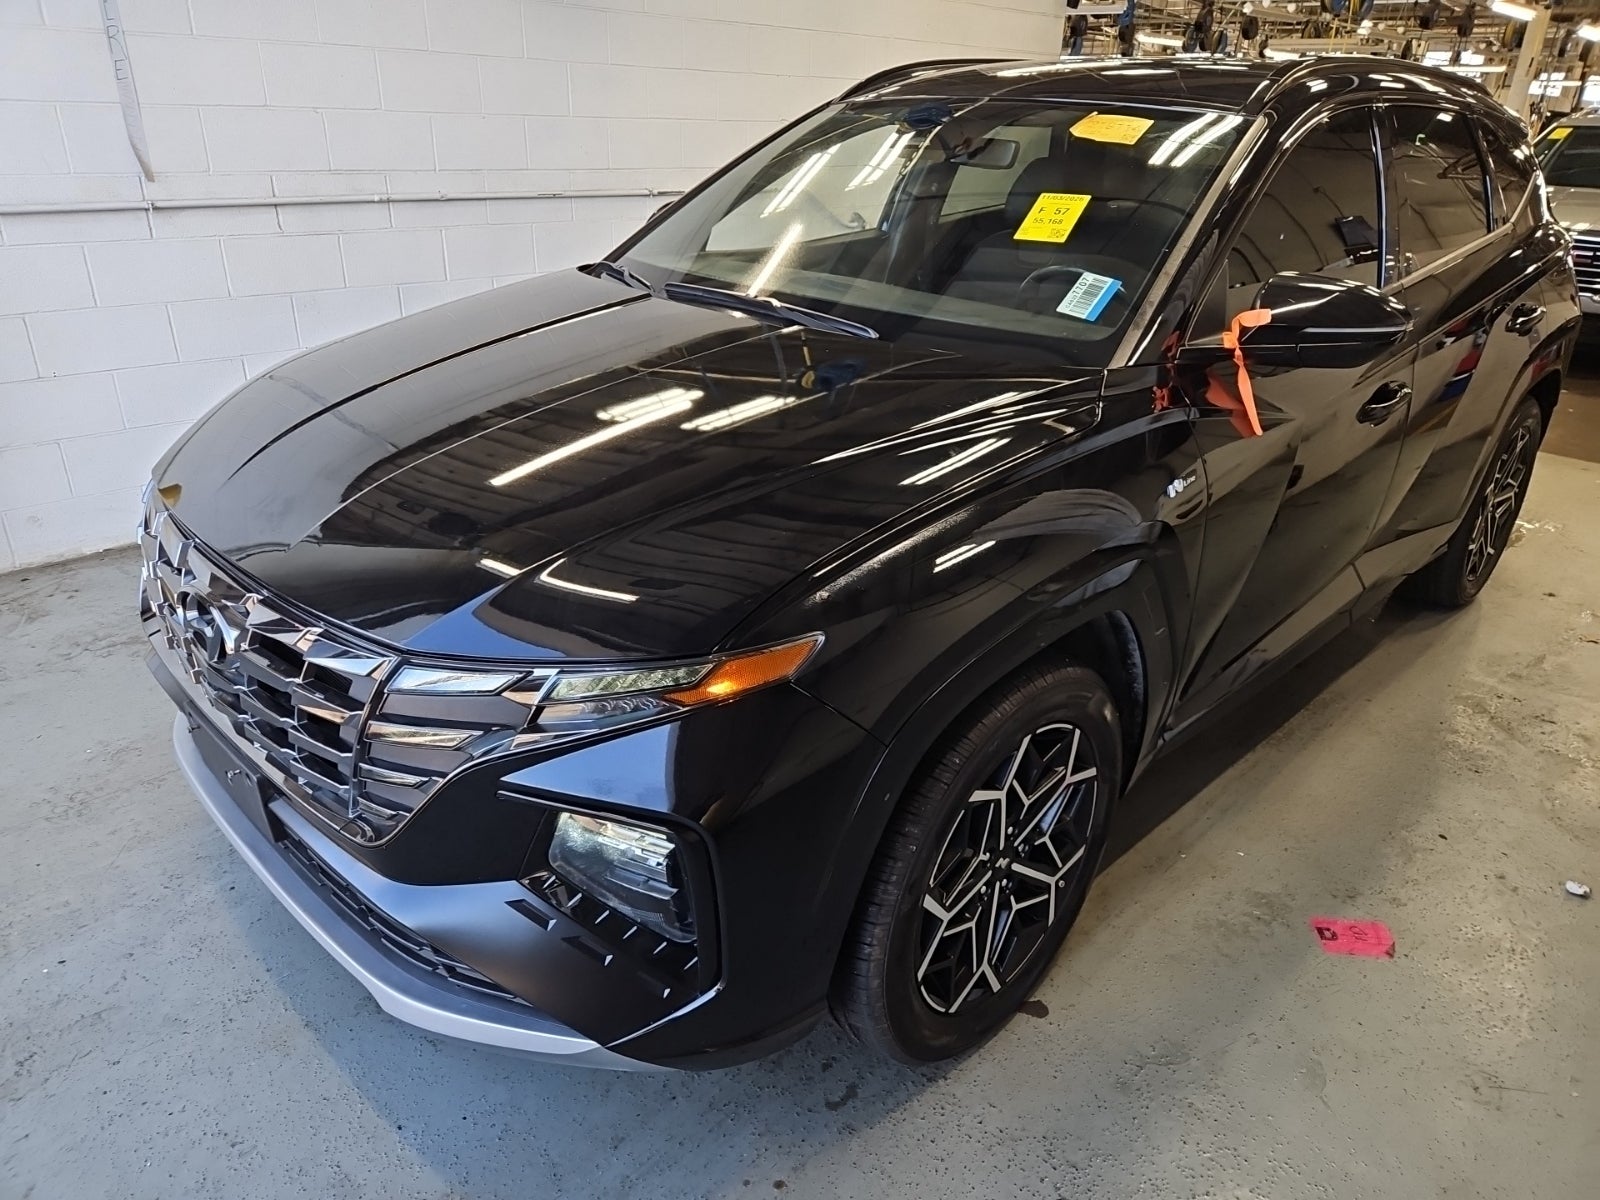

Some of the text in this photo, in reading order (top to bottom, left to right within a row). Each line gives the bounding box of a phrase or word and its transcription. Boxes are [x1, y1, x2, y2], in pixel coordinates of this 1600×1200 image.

[1038, 206, 1071, 216] F 57
[1032, 217, 1064, 225] 55,168
